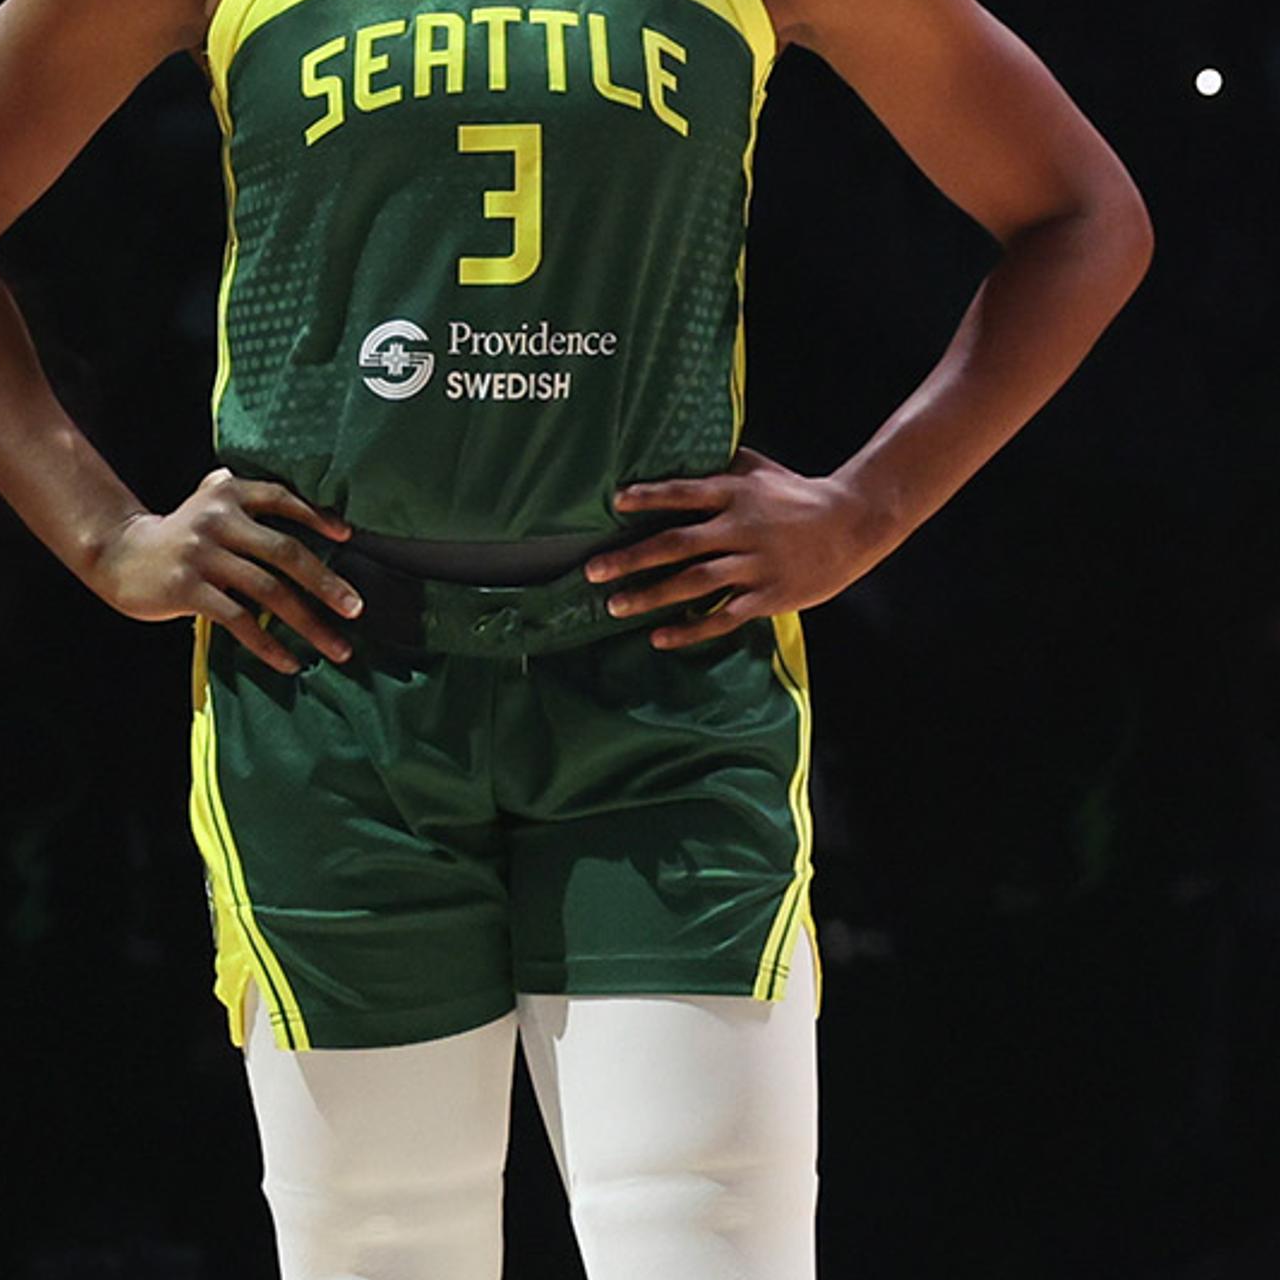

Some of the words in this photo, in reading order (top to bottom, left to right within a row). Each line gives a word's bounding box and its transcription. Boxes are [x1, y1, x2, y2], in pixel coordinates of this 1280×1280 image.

[302, 7, 689, 147] SEATTLE
[457, 123, 543, 286] 3
[447, 322, 618, 357] Providence
[446, 372, 571, 400] SWEDISH
